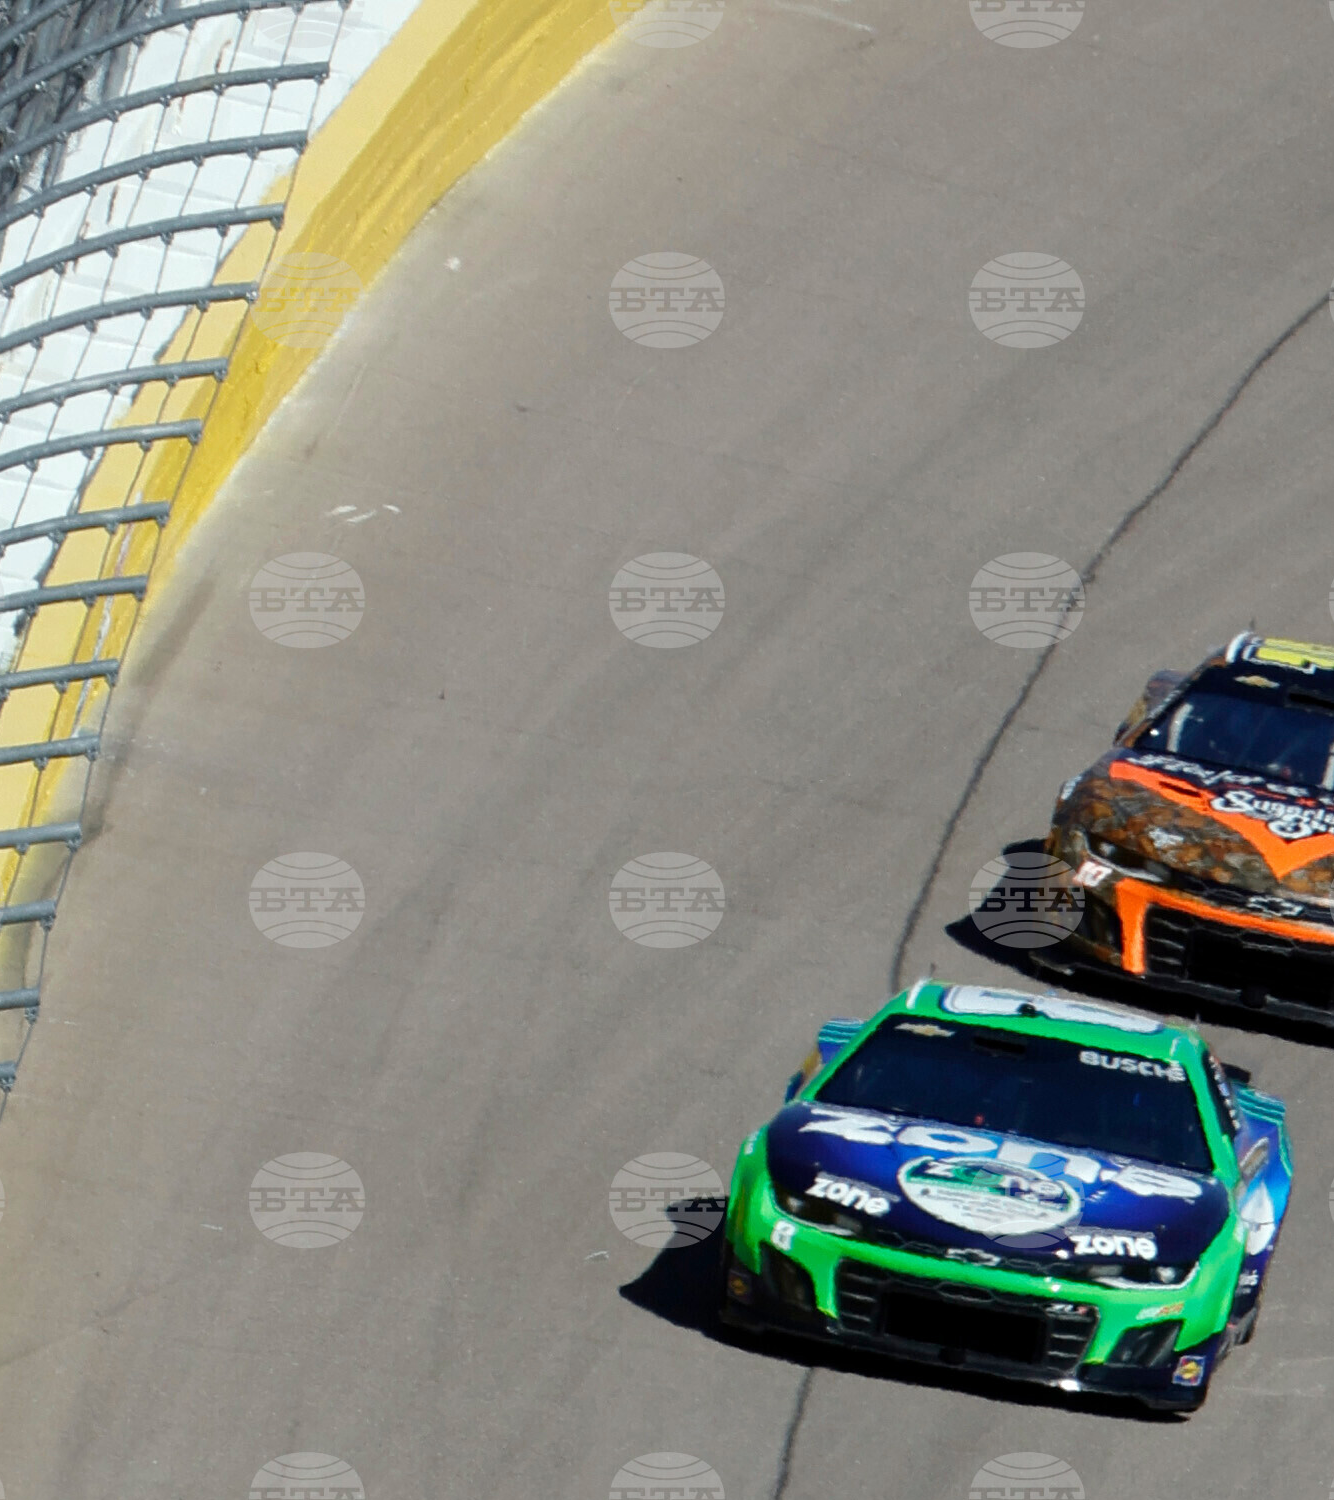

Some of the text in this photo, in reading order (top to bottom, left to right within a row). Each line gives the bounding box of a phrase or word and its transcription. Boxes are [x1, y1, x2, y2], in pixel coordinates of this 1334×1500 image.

[806, 1175, 891, 1217] zone
[770, 1219, 795, 1252] 8
[1069, 1231, 1159, 1260] zone
